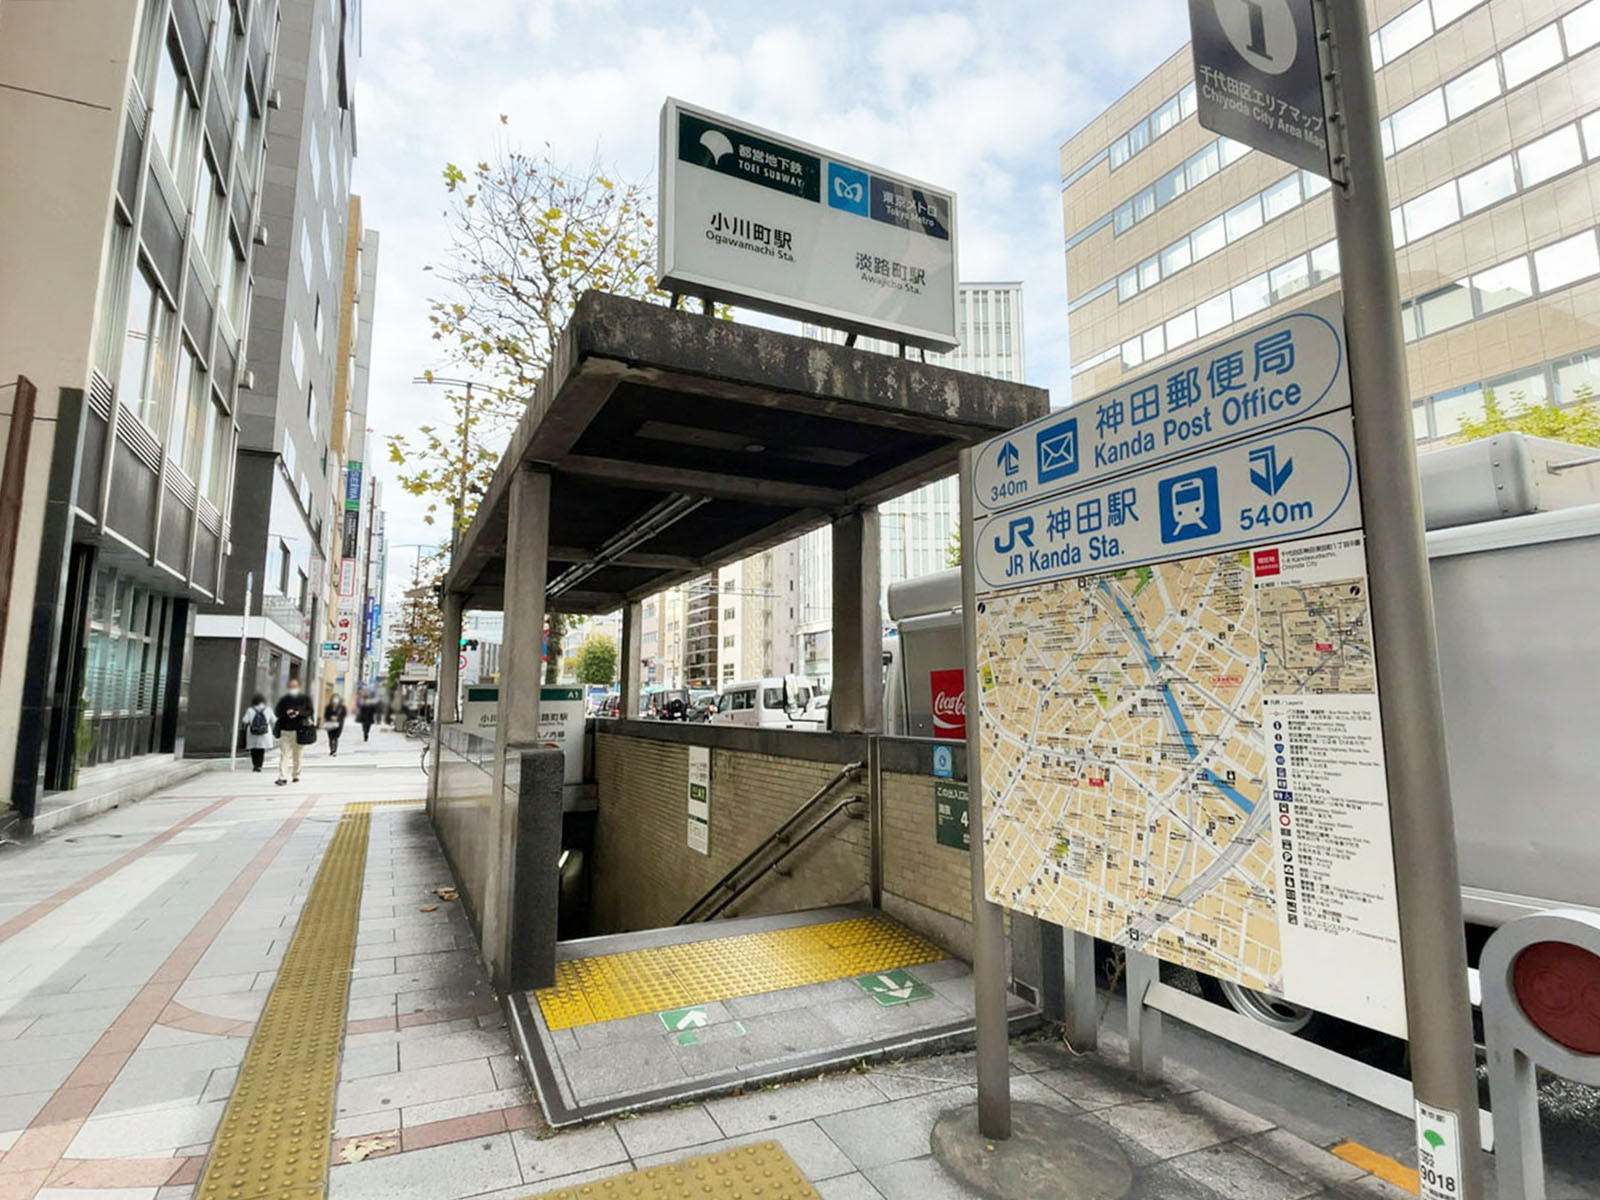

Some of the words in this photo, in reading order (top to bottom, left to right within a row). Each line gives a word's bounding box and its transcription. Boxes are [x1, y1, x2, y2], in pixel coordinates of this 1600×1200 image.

[1202, 84, 1250, 116] Chiyoda
[1252, 107, 1274, 130] City
[1278, 117, 1302, 139] Area
[1304, 129, 1326, 150] Map
[738, 144, 803, 175] 都営地下鉄
[739, 159, 760, 174] TOEI
[764, 168, 803, 188] SUBWAY
[882, 190, 937, 217] 東京メトロ
[706, 230, 775, 257] Ogawamachi
[777, 249, 797, 263] Sta.
[710, 212, 792, 251] 小川町駅
[856, 251, 926, 286] 淡路町駅
[1096, 329, 1295, 439] 神田郵便局
[1094, 430, 1155, 468] Kanda
[1163, 406, 1212, 445] Post
[1222, 382, 1302, 426] Office
[991, 479, 1028, 502] 340m
[994, 516, 1035, 554] JR
[1046, 487, 1139, 543] 神田駅
[1240, 499, 1313, 531] 540m
[1006, 554, 1024, 577] JR
[1030, 543, 1081, 572] Kanda
[1089, 534, 1125, 561] Sta.
[567, 690, 579, 699] A1
[1420, 1165, 1455, 1192] 9018
